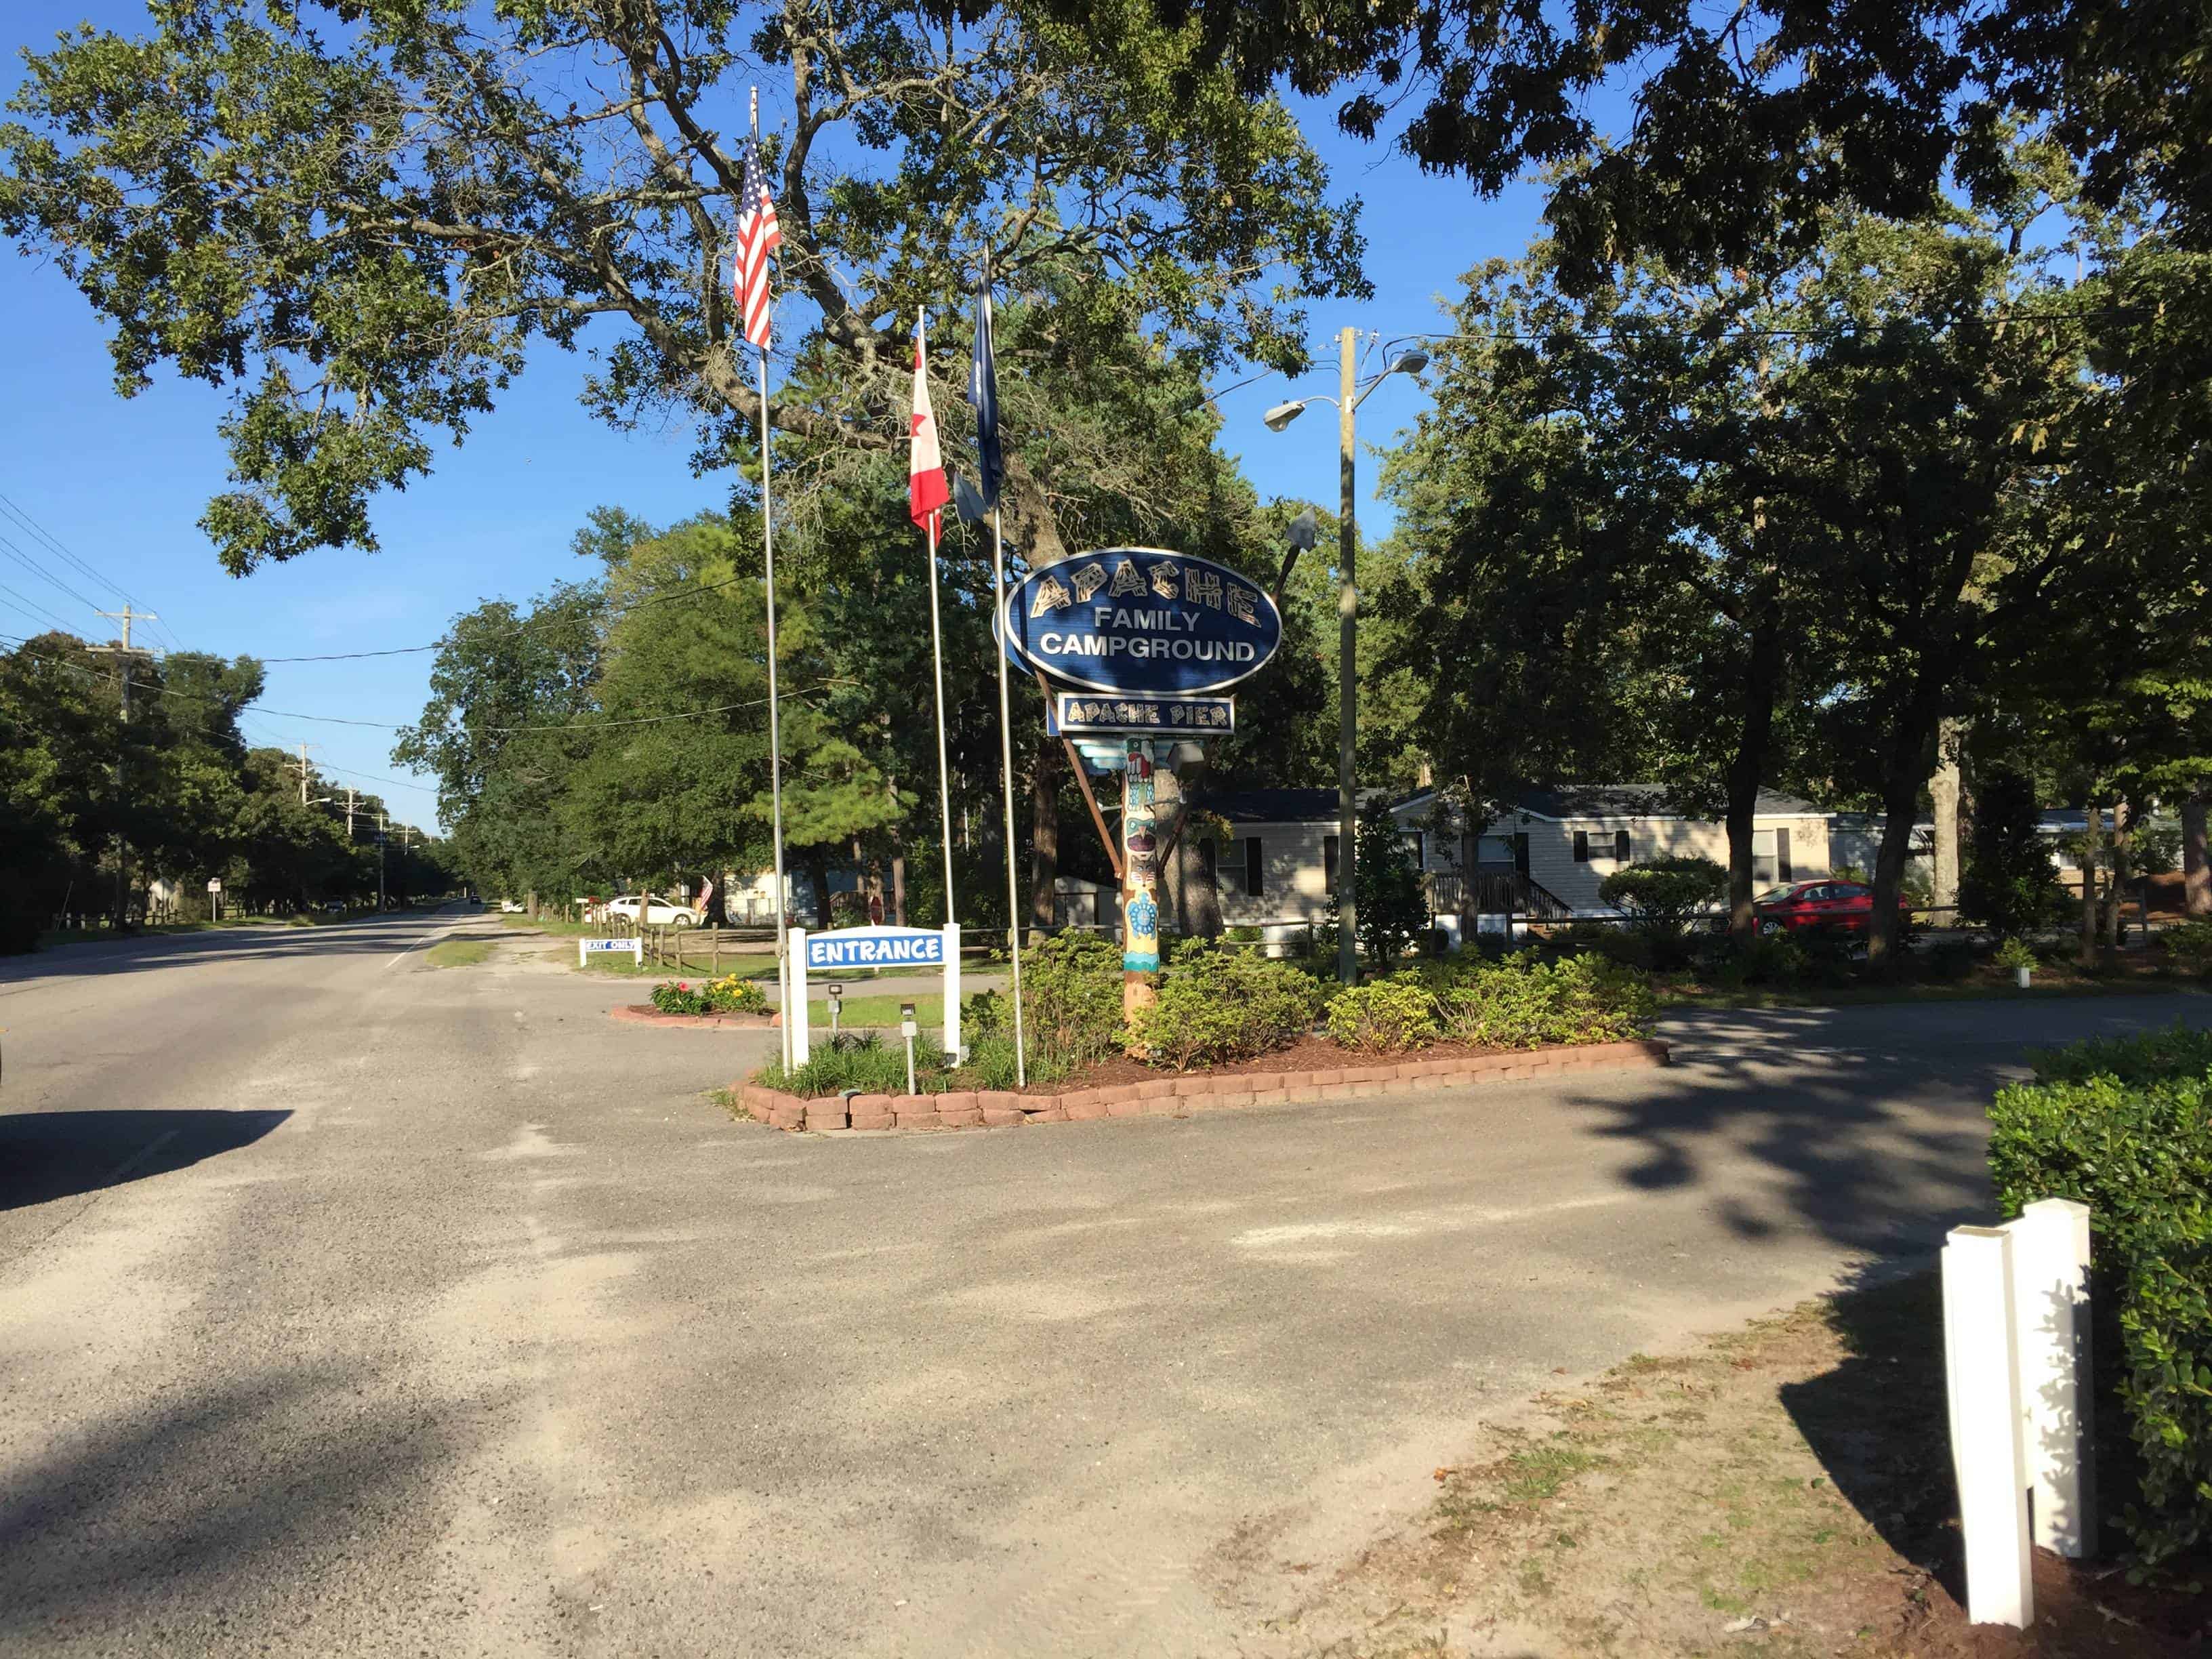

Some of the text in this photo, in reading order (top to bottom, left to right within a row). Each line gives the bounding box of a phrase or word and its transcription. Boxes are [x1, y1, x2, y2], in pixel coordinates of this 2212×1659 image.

[1030, 559, 1261, 628] APACHE
[1094, 607, 1200, 632] FAMILY
[1040, 633, 1255, 661] CAMPGROUND
[1067, 701, 1227, 726] APACHE PIER
[586, 941, 634, 949] EXIT ONLY
[811, 938, 941, 963] ENTRANCE
